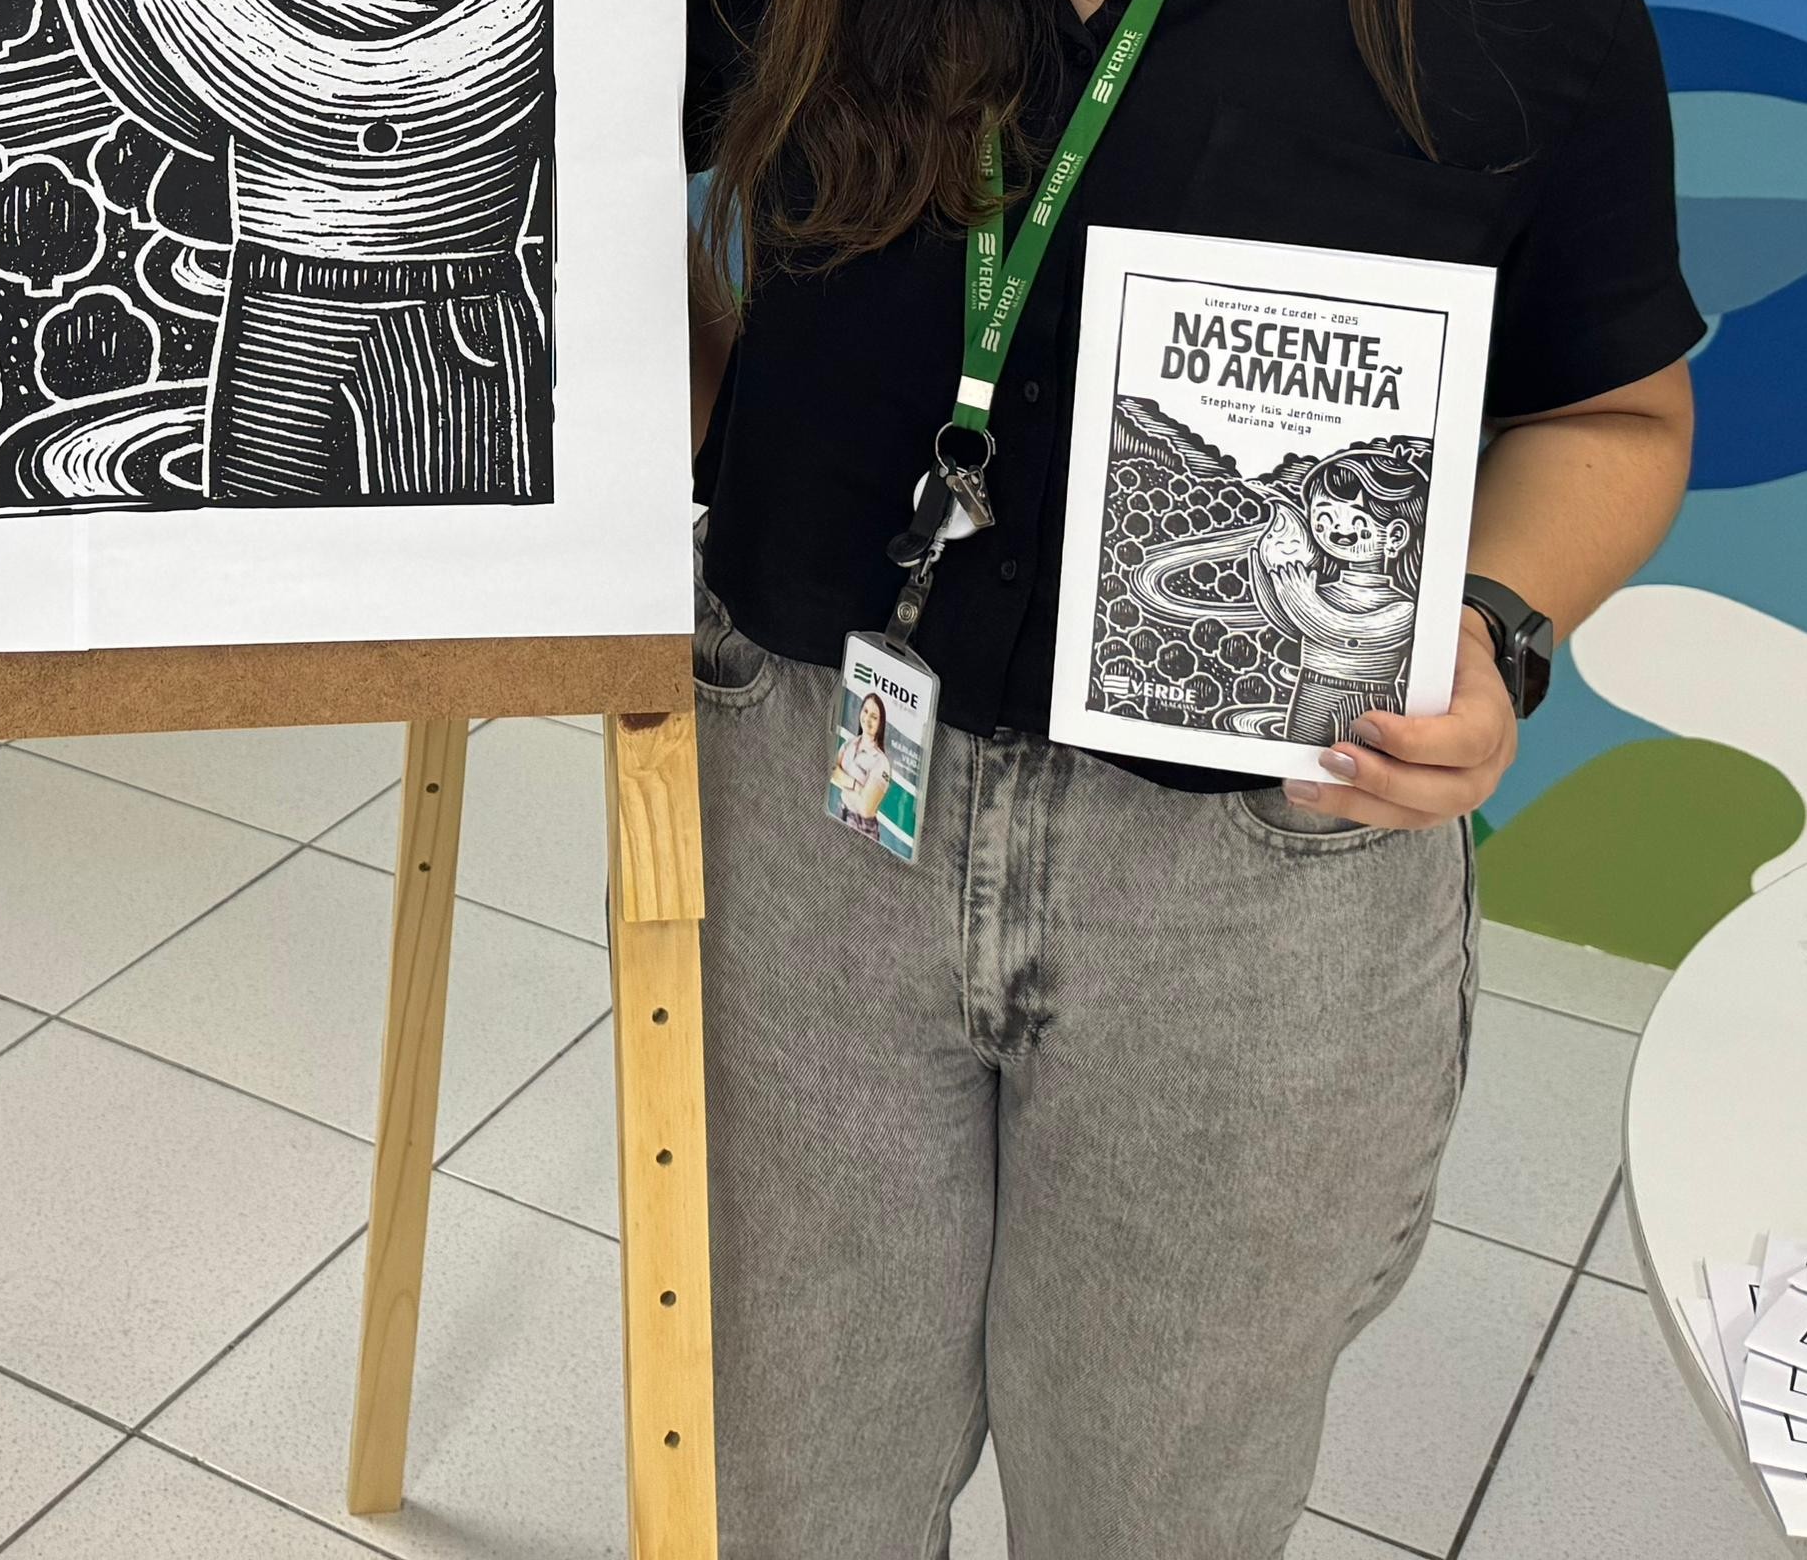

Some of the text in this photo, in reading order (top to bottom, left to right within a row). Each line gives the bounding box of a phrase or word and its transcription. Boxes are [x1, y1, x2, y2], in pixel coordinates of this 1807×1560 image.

[1101, 29, 1138, 80] VERDE
[1042, 151, 1077, 203] VERDE
[978, 256, 993, 311] VERDE
[989, 275, 1020, 328] VERDE
[1205, 299, 1259, 312] Literatura
[1282, 308, 1316, 319] Cordel
[1332, 315, 1357, 325] 2025
[1173, 312, 1380, 370] NASCENTE
[1161, 346, 1402, 410] DO AMANHÃ
[1202, 396, 1341, 423] Stephany Isis Jerônimo
[1228, 414, 1311, 434] Mariana Veiga
[873, 672, 918, 710] VERDE
[1131, 679, 1197, 704] VERDE
